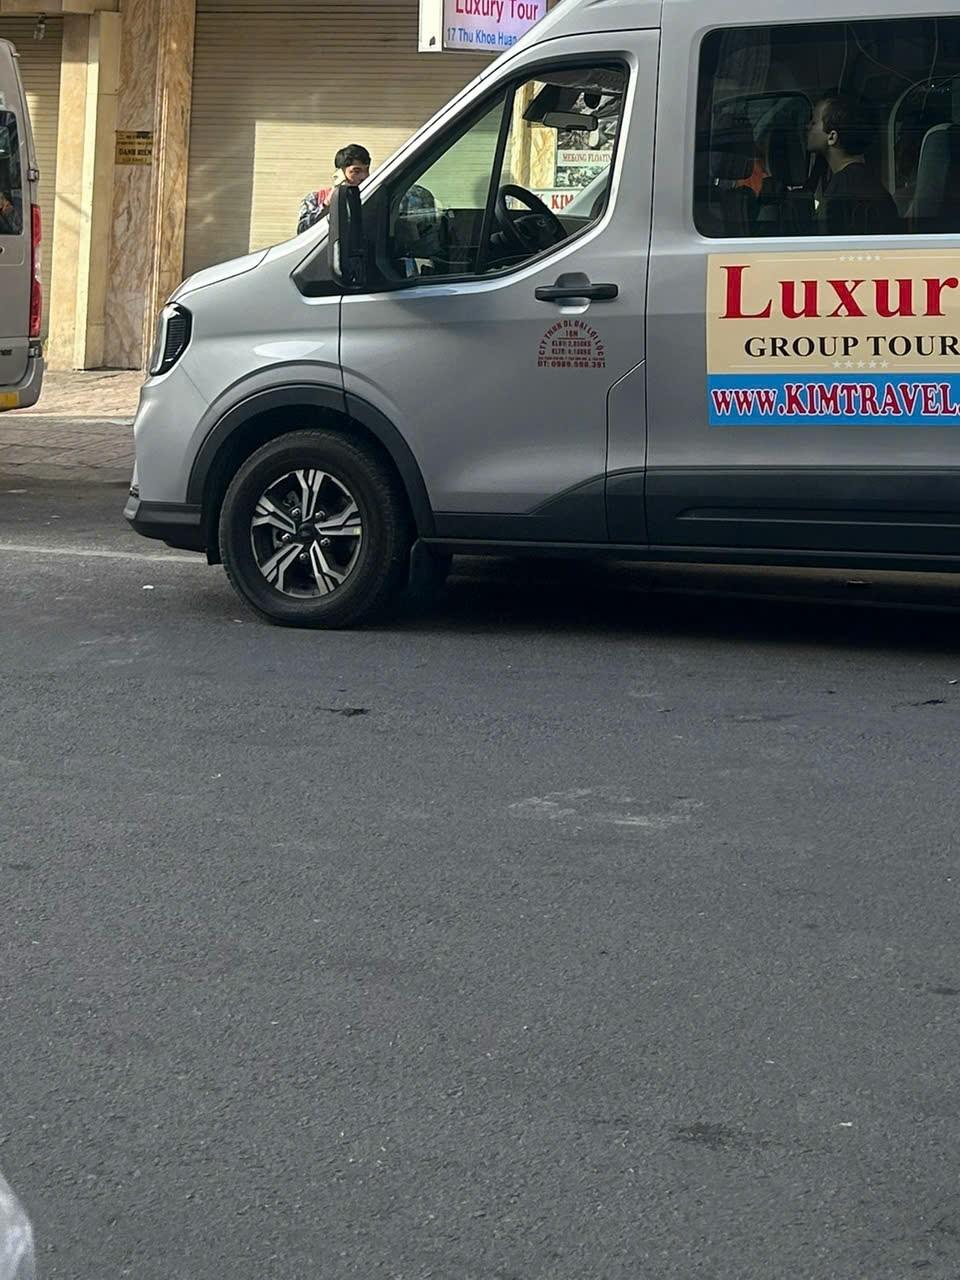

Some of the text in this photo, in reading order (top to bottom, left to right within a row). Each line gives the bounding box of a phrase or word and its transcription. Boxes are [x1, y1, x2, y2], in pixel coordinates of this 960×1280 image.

[447, 28, 456, 41] 17
[458, 28, 473, 43] Thu
[475, 30, 496, 45] Khoa
[744, 335, 859, 358] GROUP
